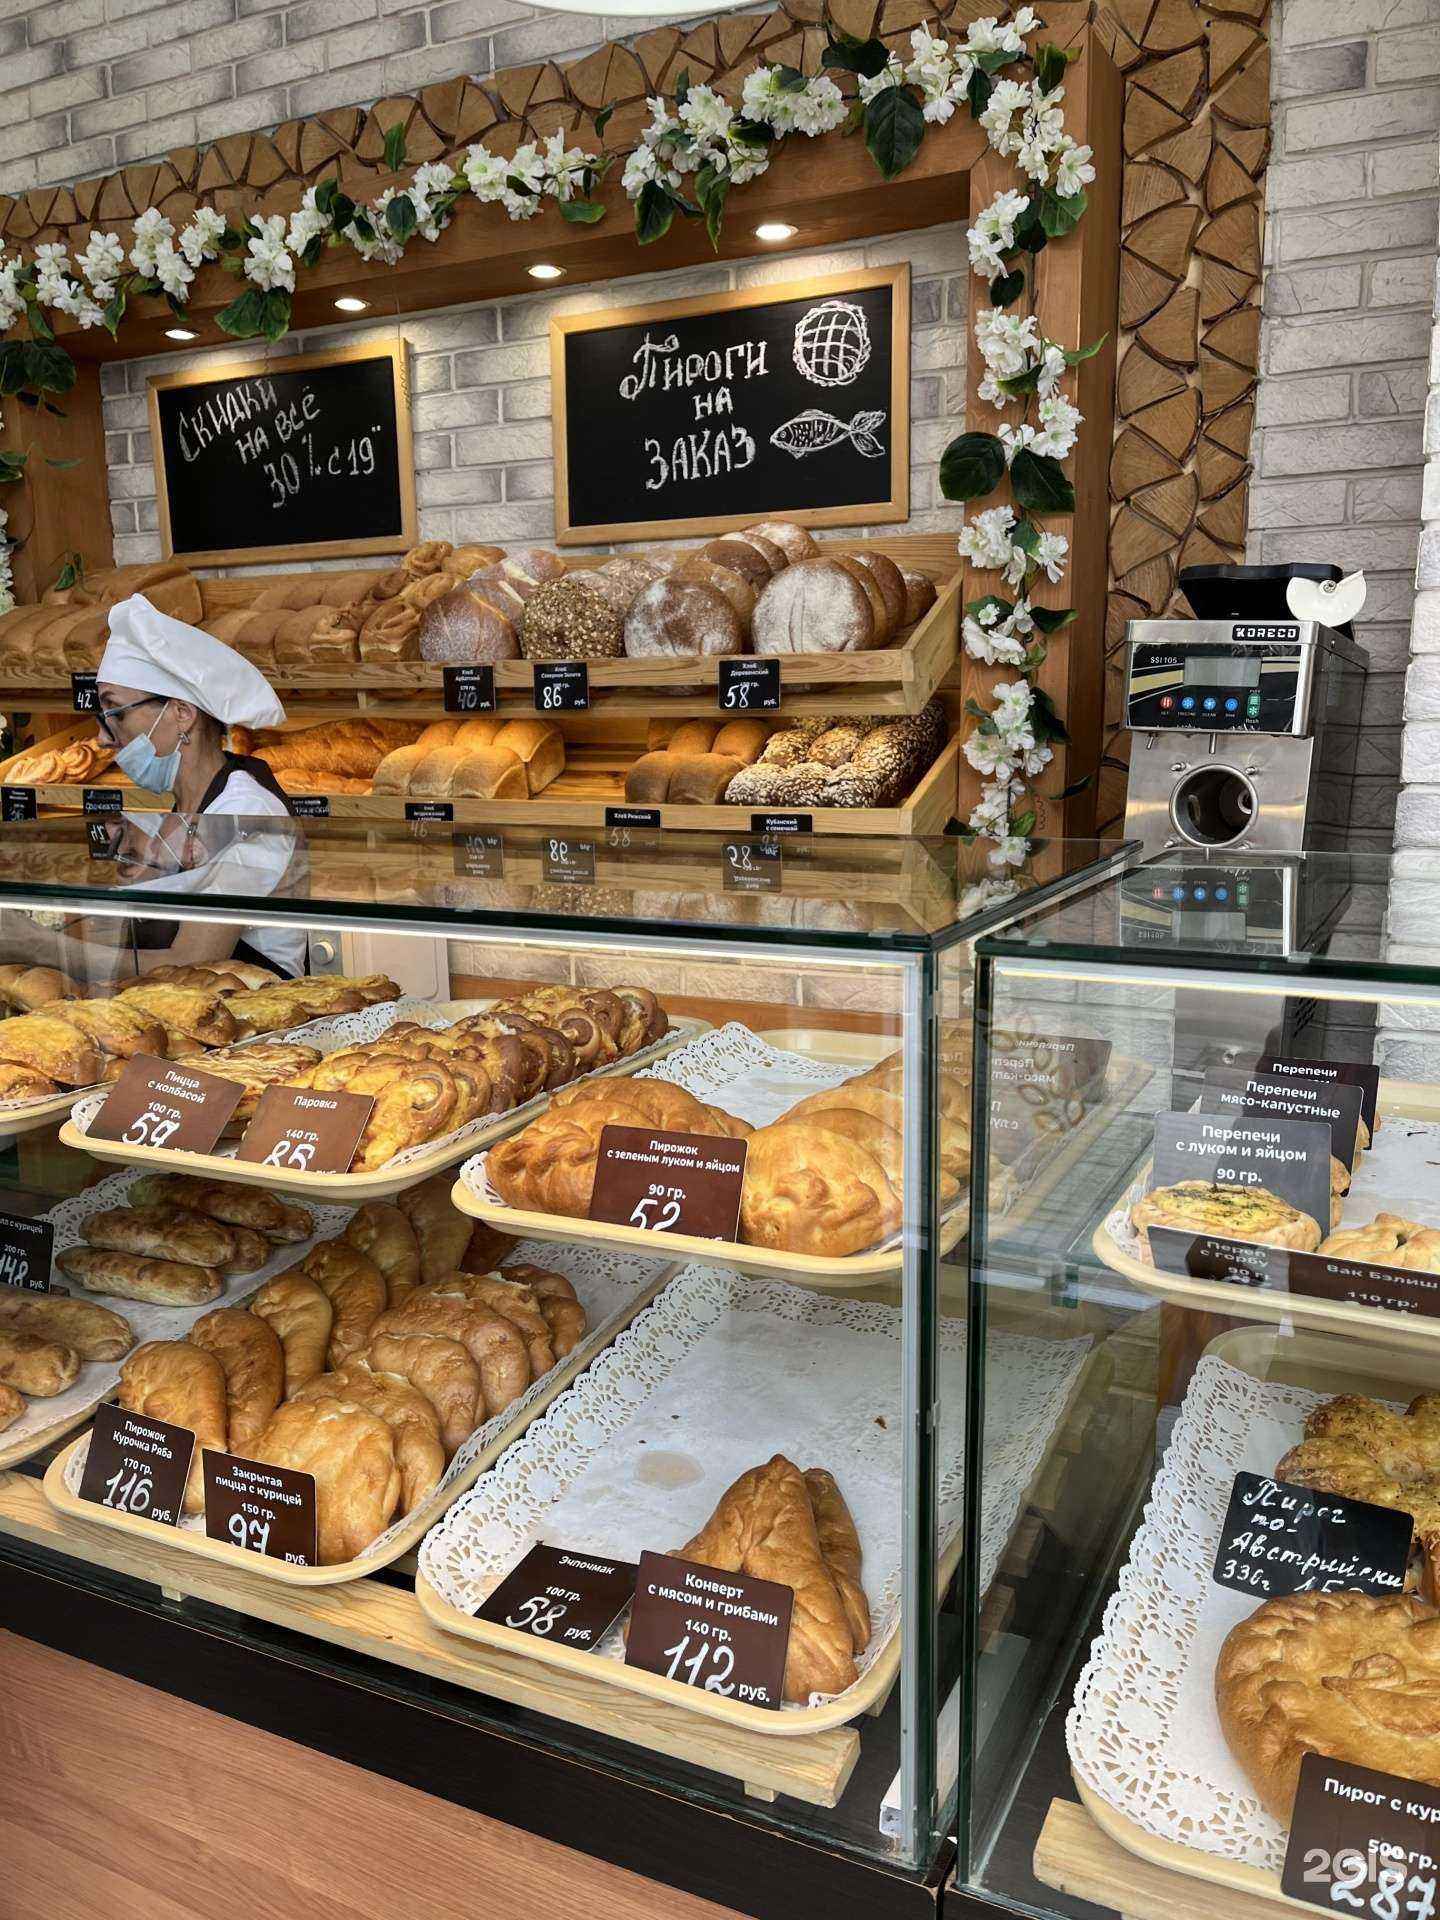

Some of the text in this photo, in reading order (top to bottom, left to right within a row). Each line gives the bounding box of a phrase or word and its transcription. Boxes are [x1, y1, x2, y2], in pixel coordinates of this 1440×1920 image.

[691, 386, 734, 421] НА
[645, 424, 757, 489] ЗАКАЗ
[1236, 627, 1297, 638] KORECO
[77, 691, 93, 709] 42
[458, 690, 478, 709] 40
[543, 686, 562, 709] 86
[724, 684, 750, 708] 58
[609, 827, 632, 848] 58
[165, 1069, 200, 1089] Пицца
[1272, 1063, 1338, 1078] Перепечи
[148, 1081, 206, 1104] с колбасой
[1246, 1080, 1317, 1101] Перепечи
[148, 1100, 182, 1121] 100 гр.
[293, 1095, 338, 1110] Паровка
[1220, 1093, 1341, 1119] мясо-капустные
[122, 1112, 181, 1149] 59
[285, 1128, 320, 1142] 140 гр.
[1202, 1125, 1281, 1144] Перепечи
[650, 1140, 698, 1155] Пирожок
[1175, 1140, 1308, 1163] с луком и яйцом
[607, 1149, 740, 1173] с зеленым луком и яйцом
[1216, 1168, 1263, 1183] 90 гр.
[648, 1183, 687, 1200] 90 гр.
[629, 1198, 681, 1232] 52
[30, 1280, 45, 1290] руб.
[1327, 1263, 1438, 1289] Вак Бэлиш
[1347, 1291, 1381, 1302] 110
[125, 1420, 167, 1443] Пирожок
[112, 1430, 173, 1460] Курочка Ряба
[122, 1457, 153, 1476] 170 гр.
[231, 1465, 283, 1489] Закрытая
[102, 1468, 173, 1522] 116 руб.
[215, 1475, 303, 1507] пицца с курицей
[241, 1502, 277, 1521] 150 гр.
[544, 1585, 581, 1603] 100 гр.
[684, 1573, 744, 1599] Конверт
[647, 1584, 779, 1627] с мясом и грибами
[505, 1595, 592, 1641] 58 руб.
[684, 1618, 733, 1643] 140 гр.
[663, 1635, 771, 1703] 112 руб.
[1323, 1777, 1387, 1806] Пирог
[1390, 1799, 1402, 1811] с
[1367, 1838, 1438, 1871] 500 гр.
